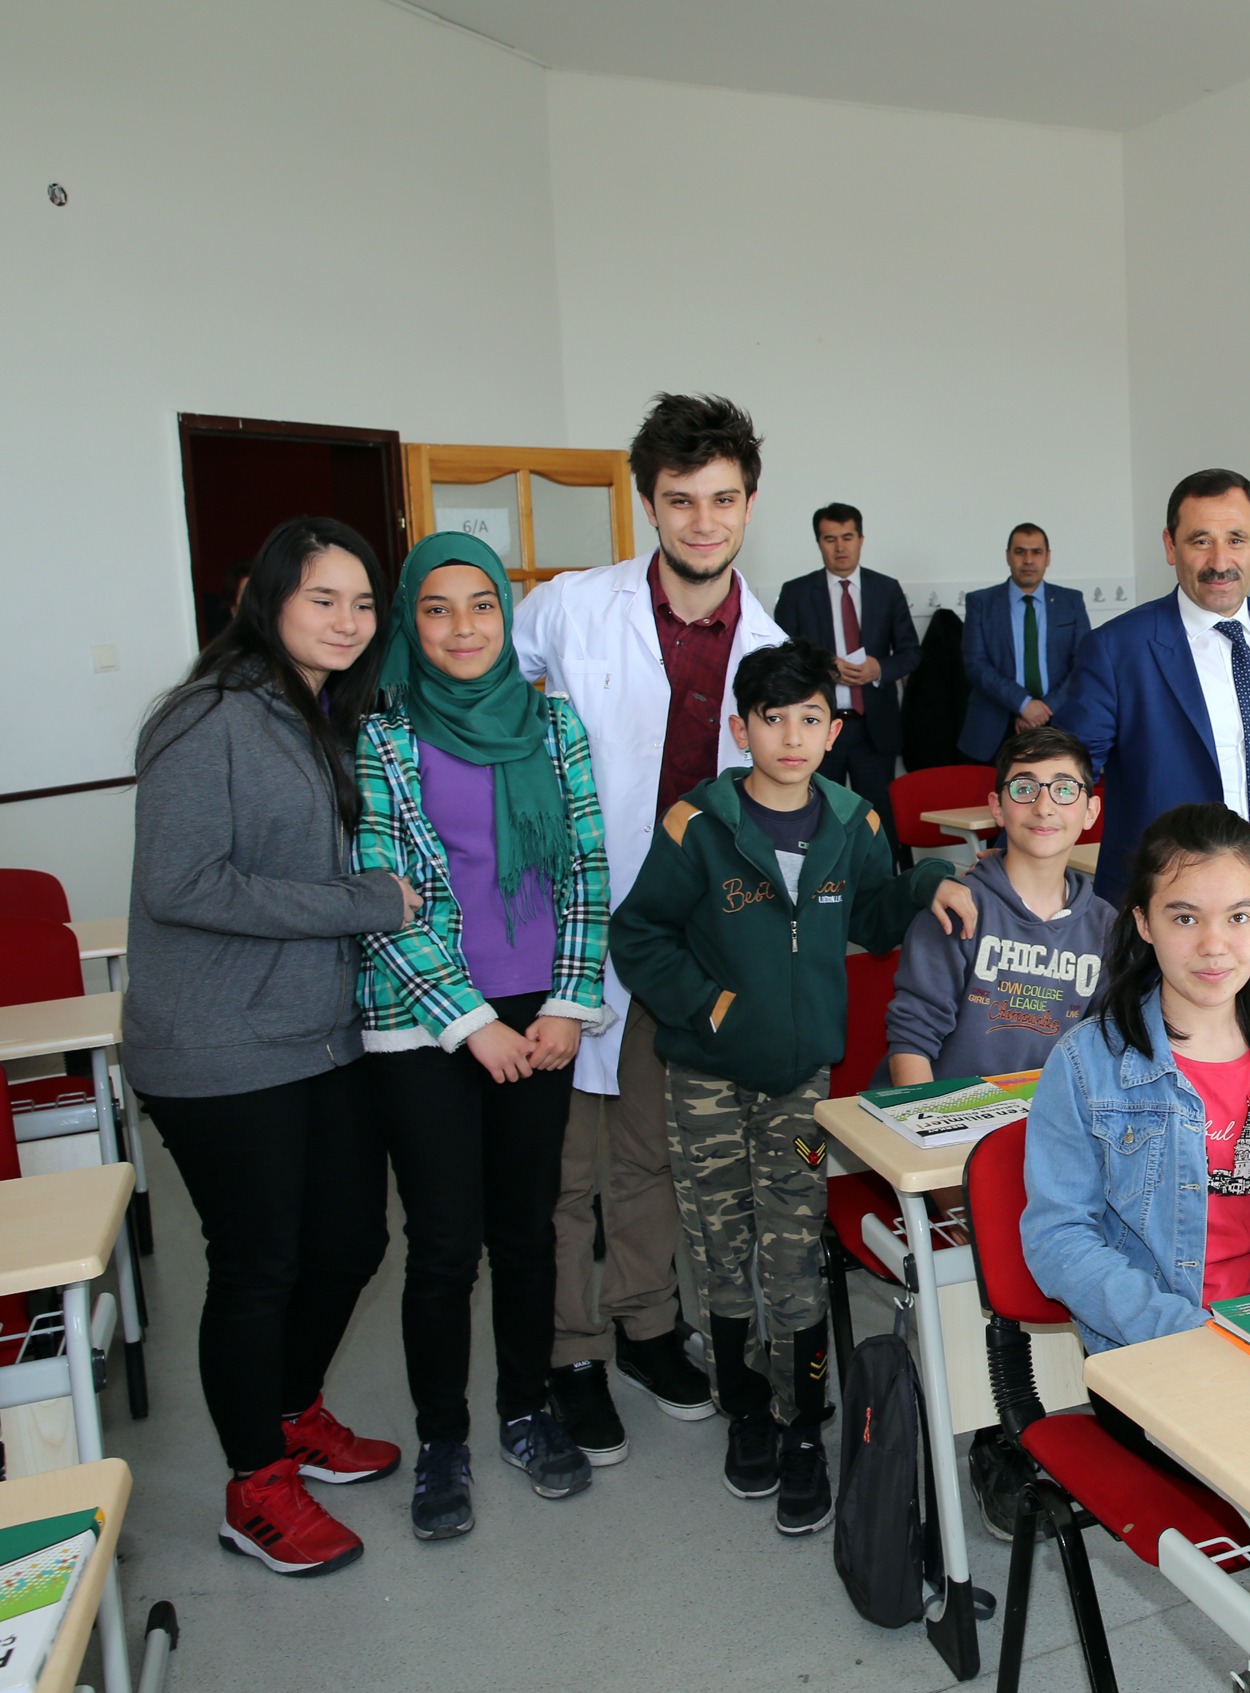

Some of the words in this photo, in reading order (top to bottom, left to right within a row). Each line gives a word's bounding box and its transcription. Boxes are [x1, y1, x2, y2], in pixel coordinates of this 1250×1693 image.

[463, 520, 488, 534] 6/A
[974, 935, 1101, 997] CHICAGO
[1022, 985, 1064, 1001] COLLEGE
[1009, 995, 1048, 1012] LEAGUE
